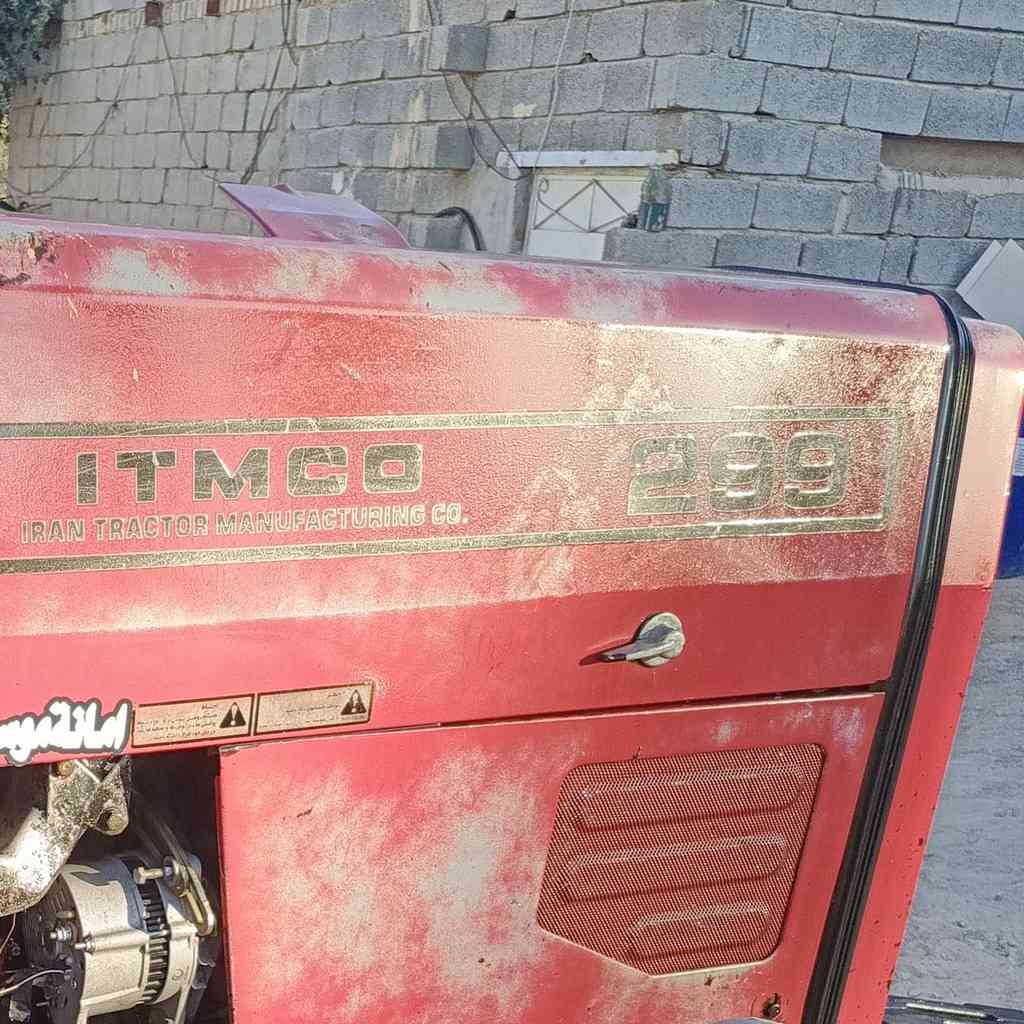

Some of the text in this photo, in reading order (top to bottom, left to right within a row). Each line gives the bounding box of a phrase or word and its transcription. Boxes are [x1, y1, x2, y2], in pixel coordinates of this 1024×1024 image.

[76, 443, 424, 506] ITMCO
[628, 430, 849, 516] 299
[19, 502, 471, 545] IRAN TRACTOR MANUFACTURING CO.
